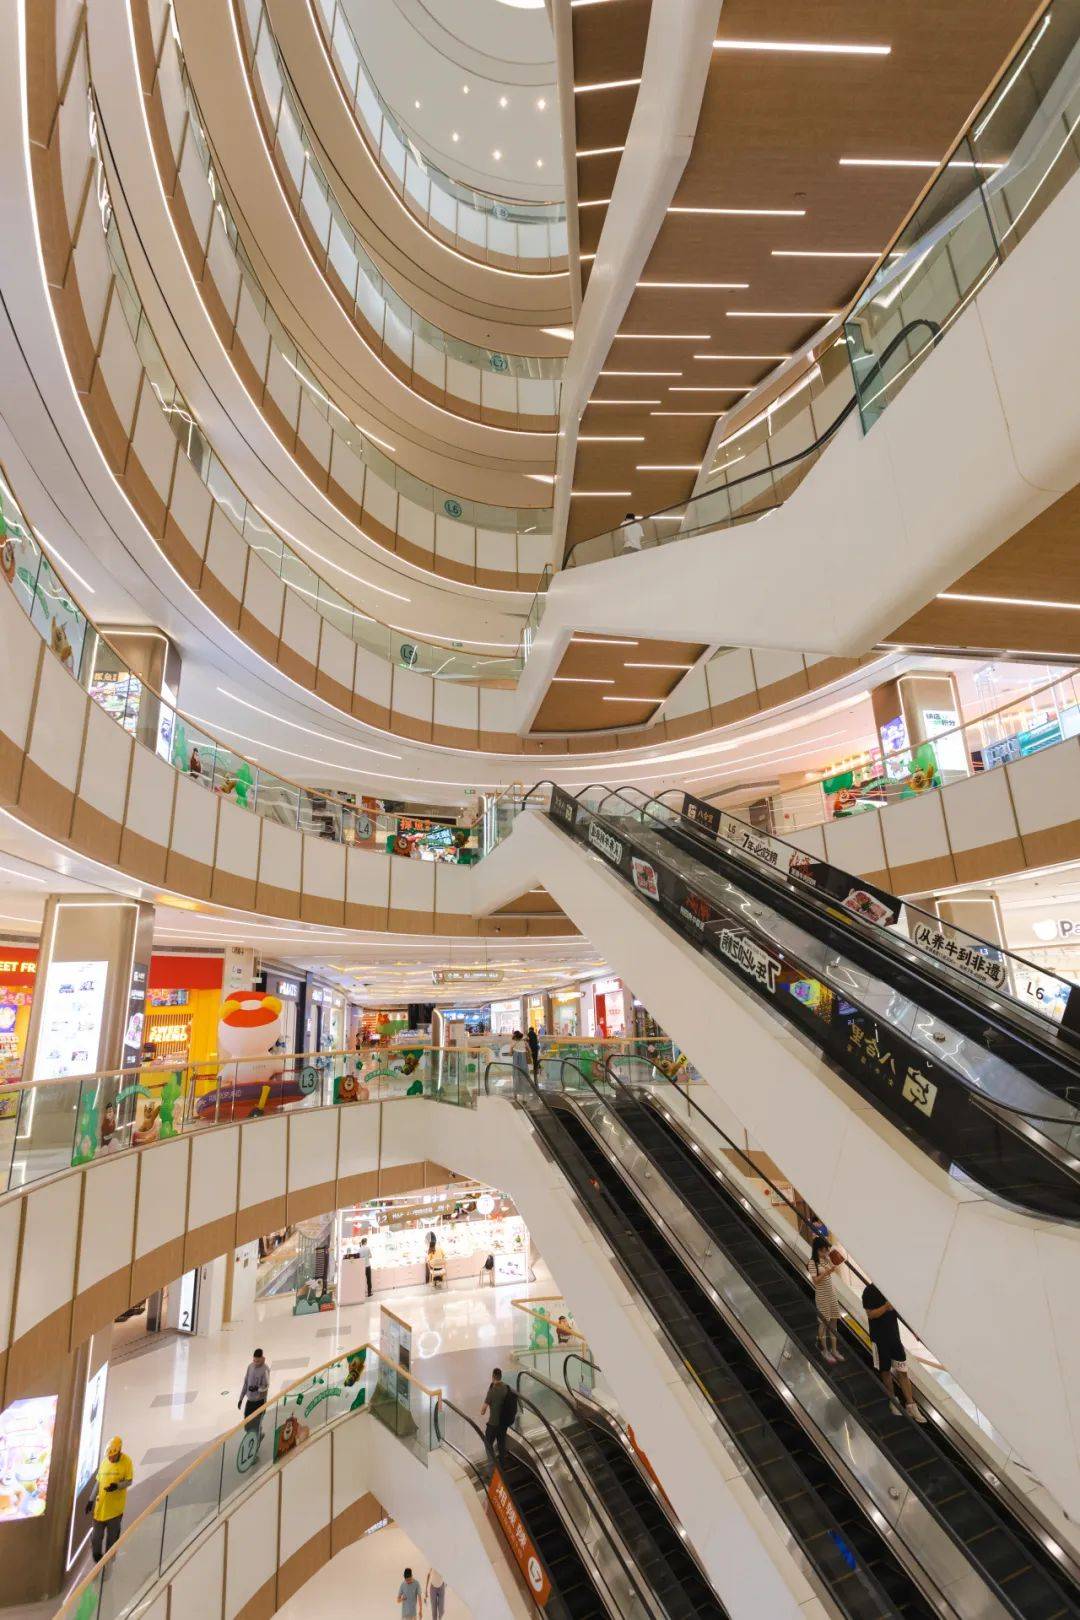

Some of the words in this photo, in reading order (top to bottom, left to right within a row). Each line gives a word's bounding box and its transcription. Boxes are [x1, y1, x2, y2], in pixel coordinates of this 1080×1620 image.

[359, 822, 370, 834] L4
[1027, 982, 1045, 1000] L6
[150, 1025, 187, 1034] SWEET
[149, 1032, 188, 1042] FRIEND
[301, 1074, 314, 1089] L3
[241, 1439, 255, 1465] L2
